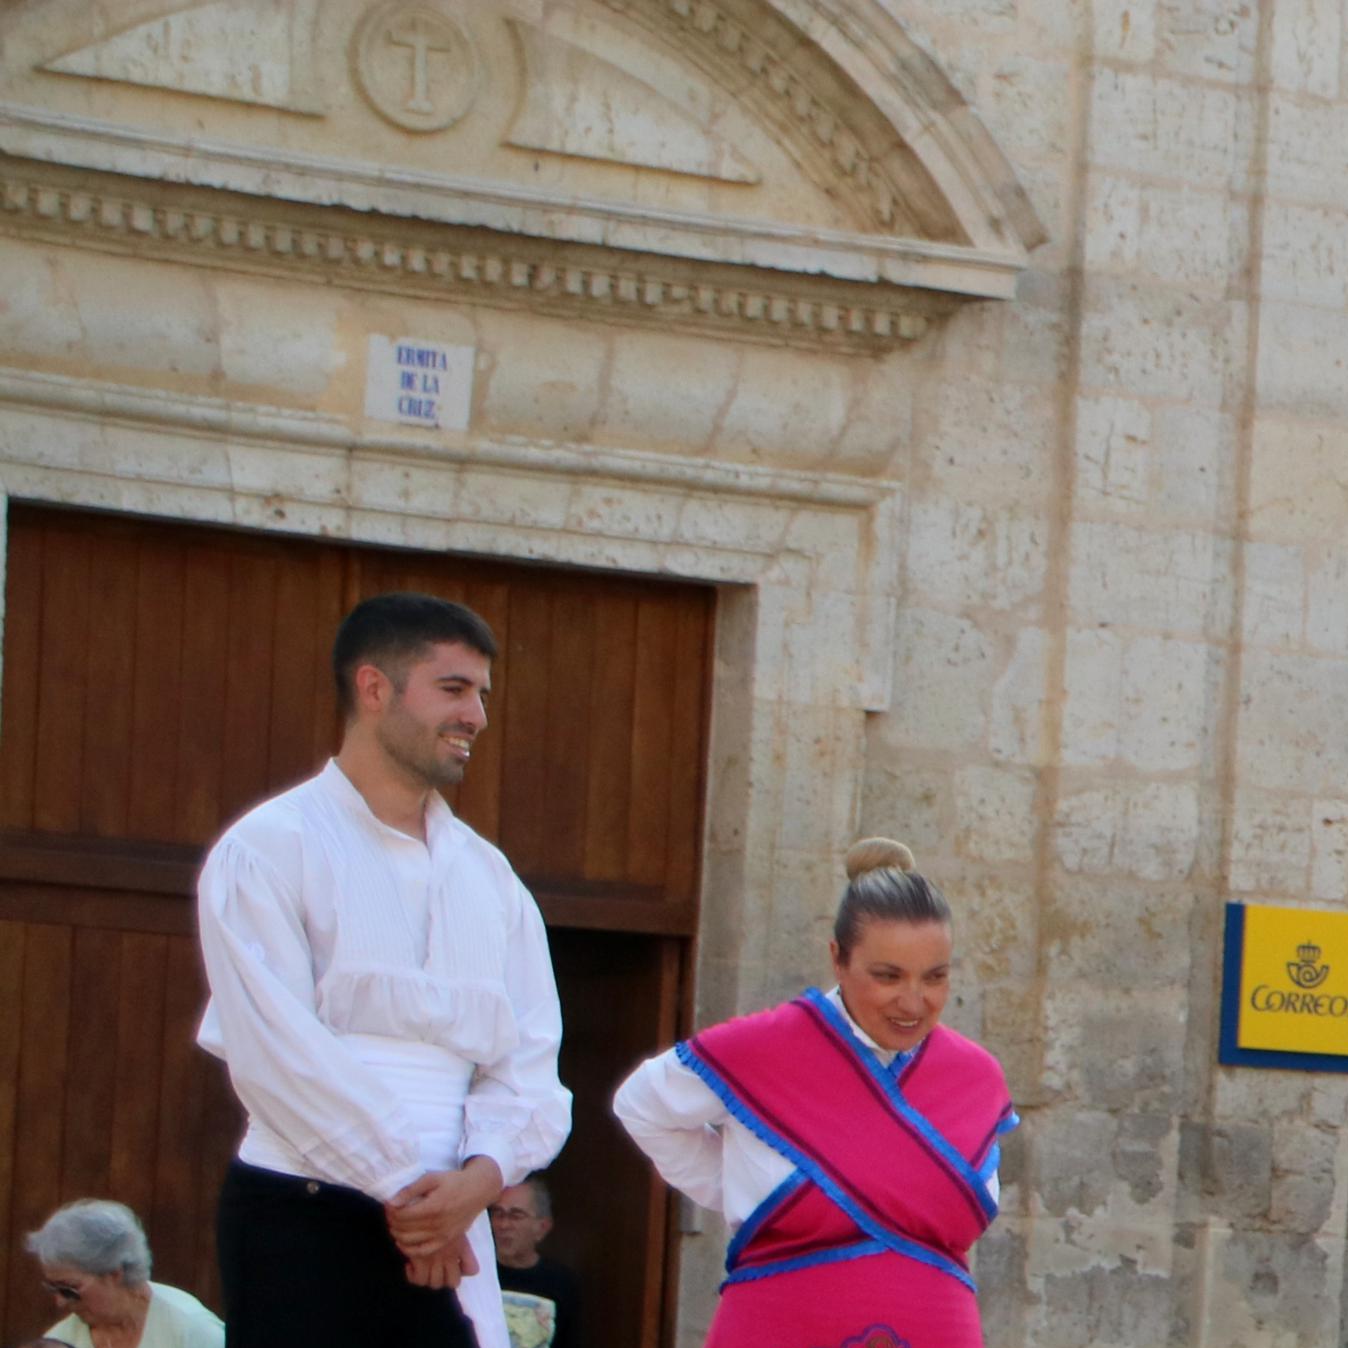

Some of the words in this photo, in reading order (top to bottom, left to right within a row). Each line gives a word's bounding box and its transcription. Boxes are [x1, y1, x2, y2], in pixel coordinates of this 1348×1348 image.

[397, 346, 448, 371] ERMITA
[401, 371, 417, 391] DE
[422, 374, 440, 394] LA
[398, 396, 436, 419] CRUZ
